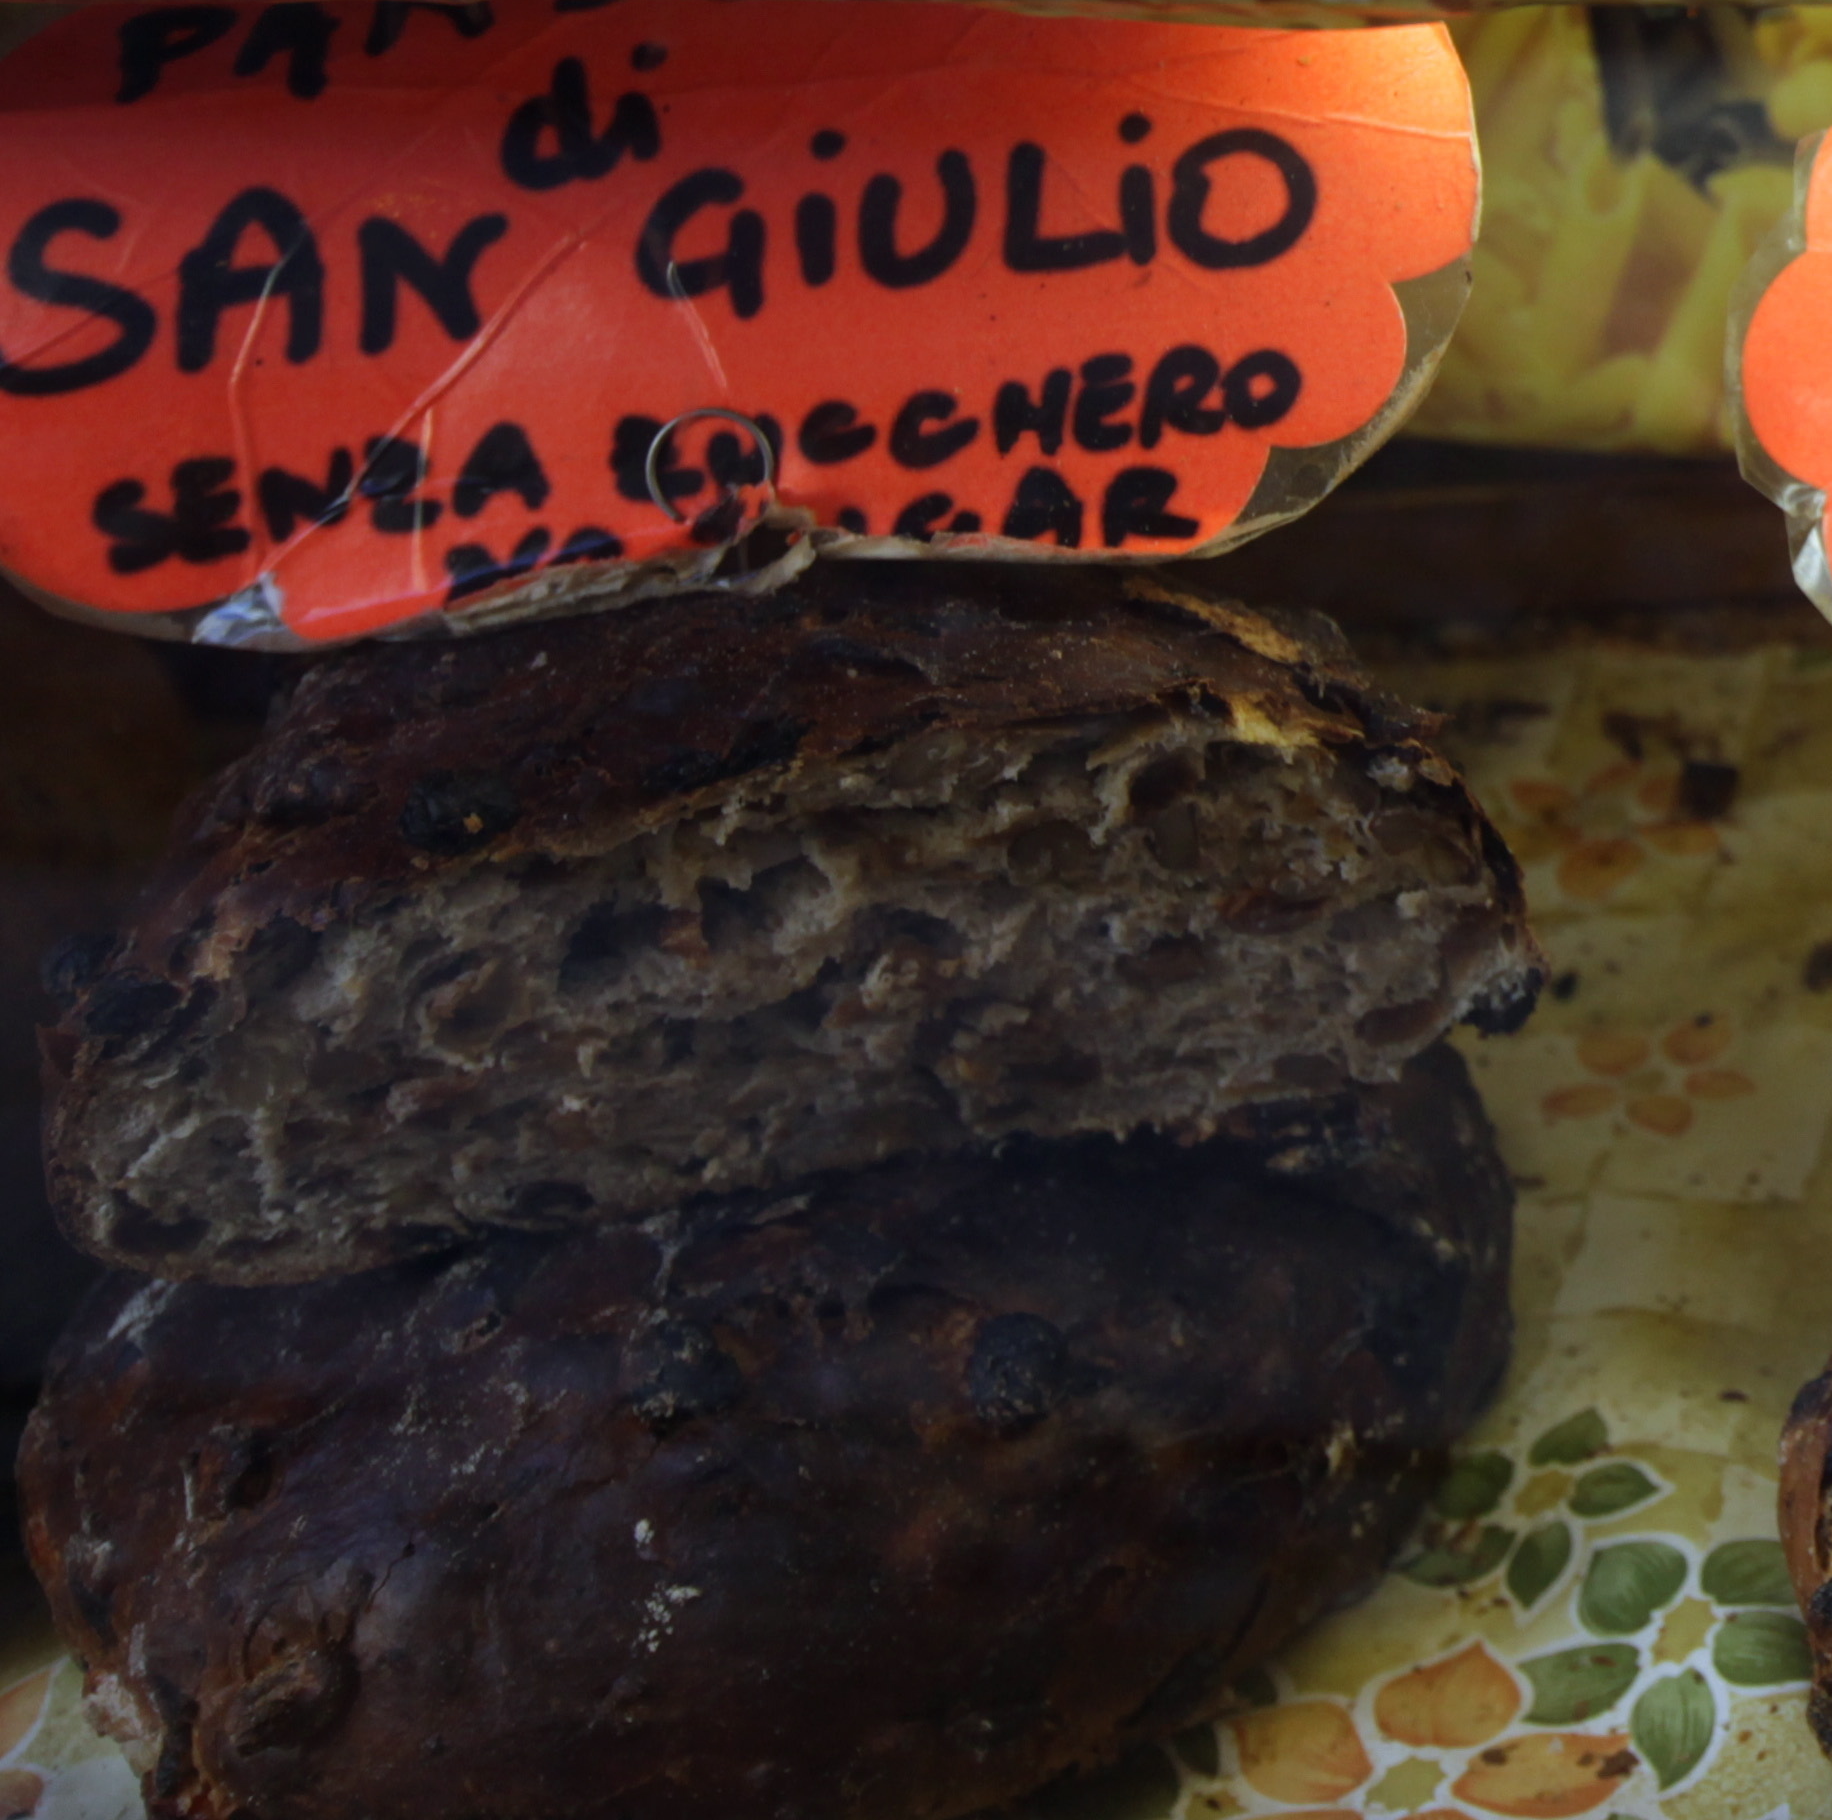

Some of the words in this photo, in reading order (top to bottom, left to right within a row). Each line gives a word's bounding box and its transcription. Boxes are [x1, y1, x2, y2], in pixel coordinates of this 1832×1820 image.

[499, 40, 662, 192] di
[0, 184, 510, 397] SAN
[92, 420, 552, 575] SENZA
